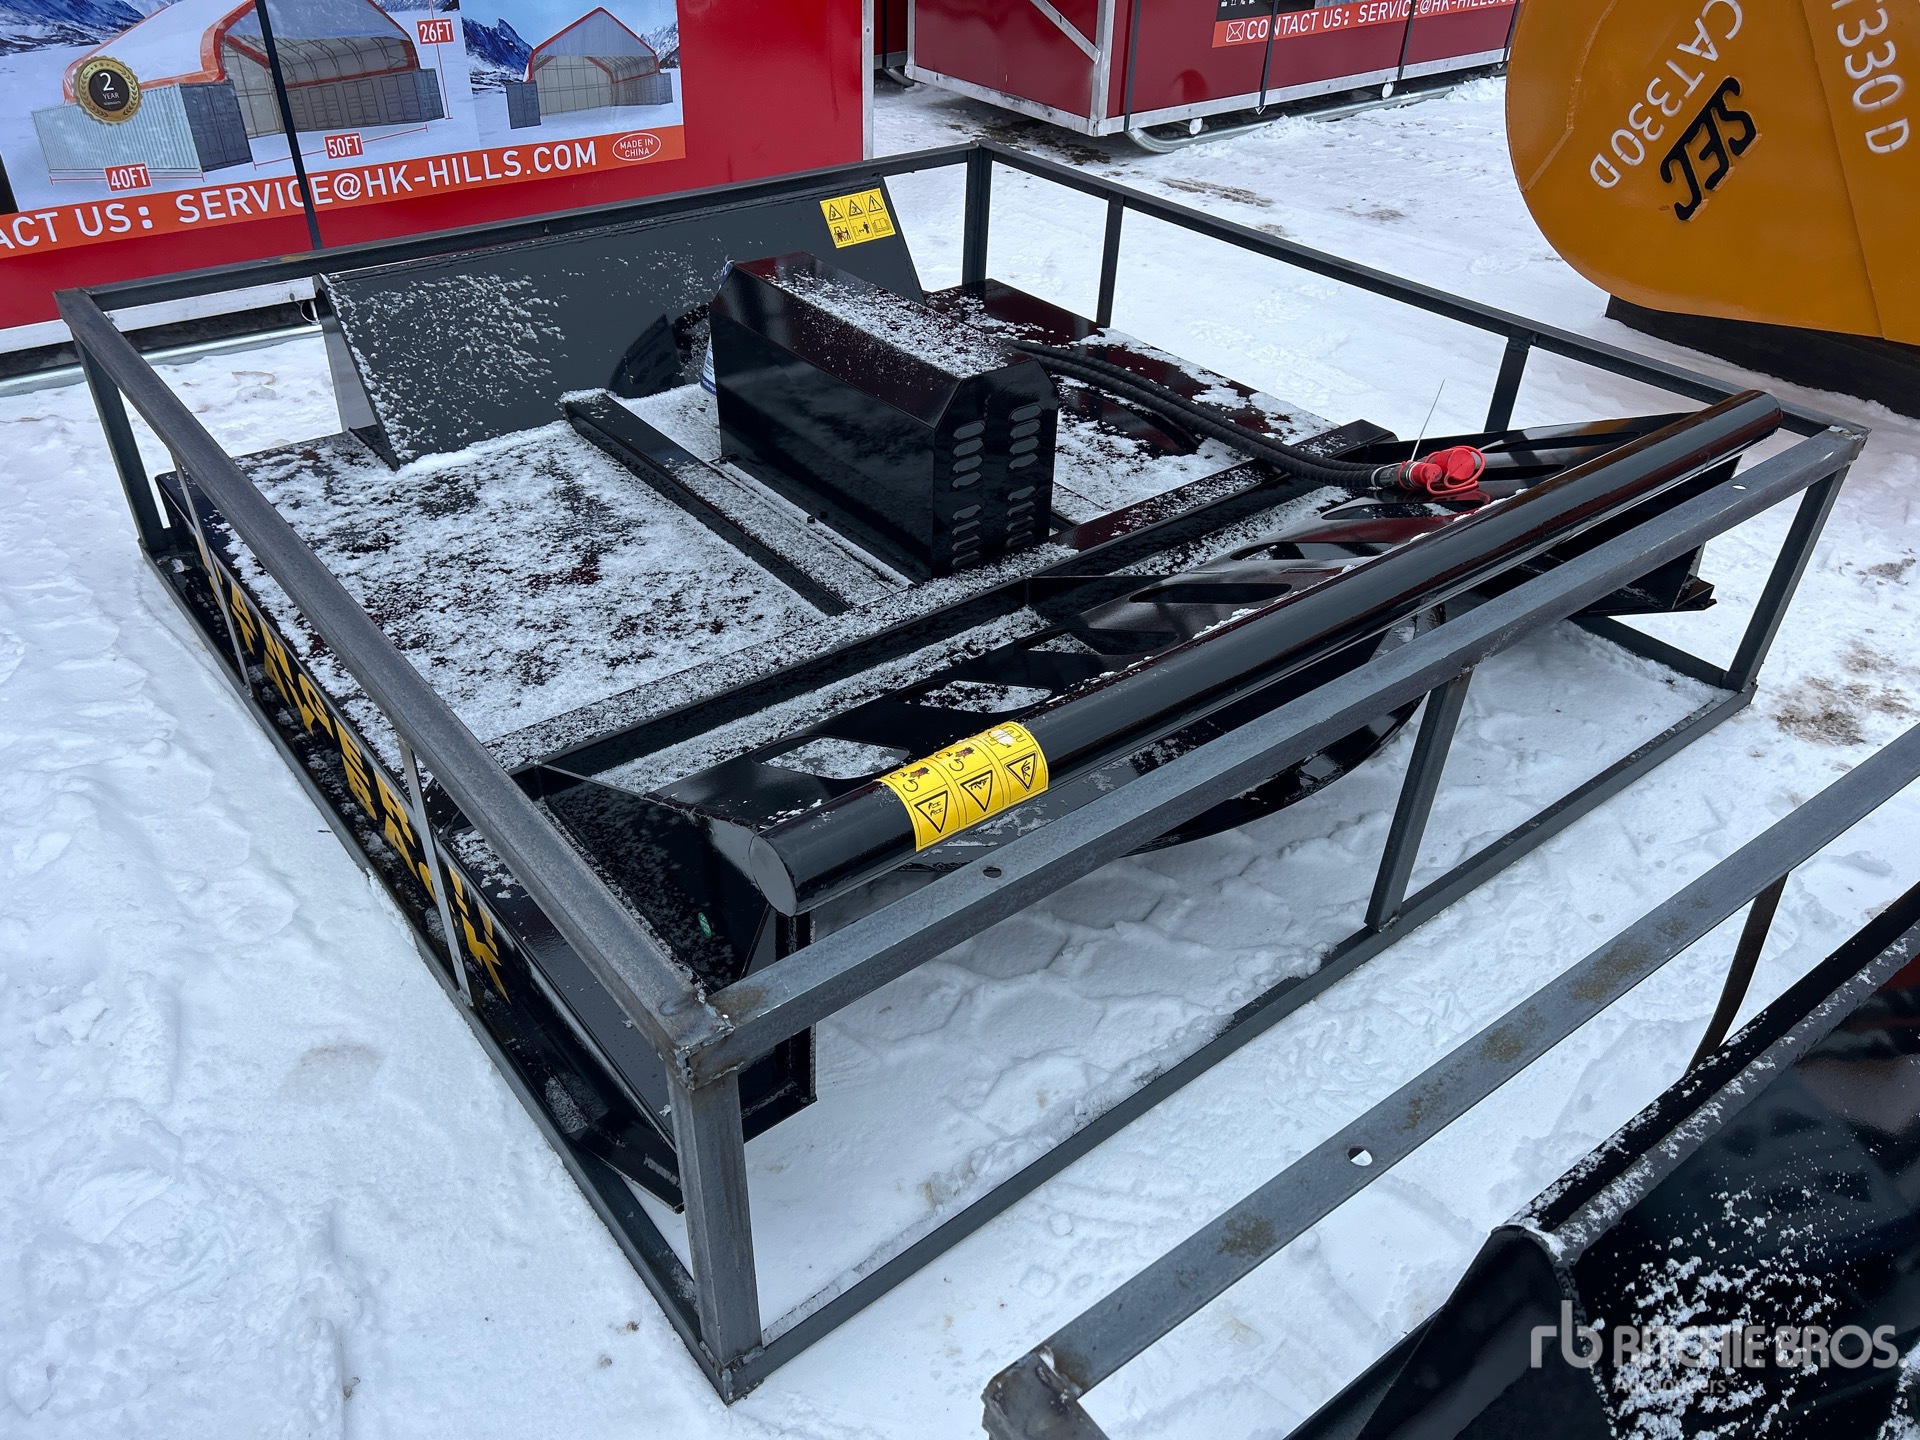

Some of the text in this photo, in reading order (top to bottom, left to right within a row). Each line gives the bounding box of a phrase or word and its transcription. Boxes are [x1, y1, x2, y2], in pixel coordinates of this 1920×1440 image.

[1323, 7, 1350, 29] US:
[419, 20, 453, 43] 26FT
[100, 72, 115, 91] 2
[102, 92, 120, 100] YEAR
[326, 134, 362, 158] 50FT
[620, 137, 654, 150] MADE IN
[624, 147, 650, 158] CHINA
[1659, 76, 1759, 222] SEC
[110, 165, 148, 189] 40FT
[74, 203, 153, 237] US:
[176, 140, 597, 223] SERVICE@HK-HILLS.COM
